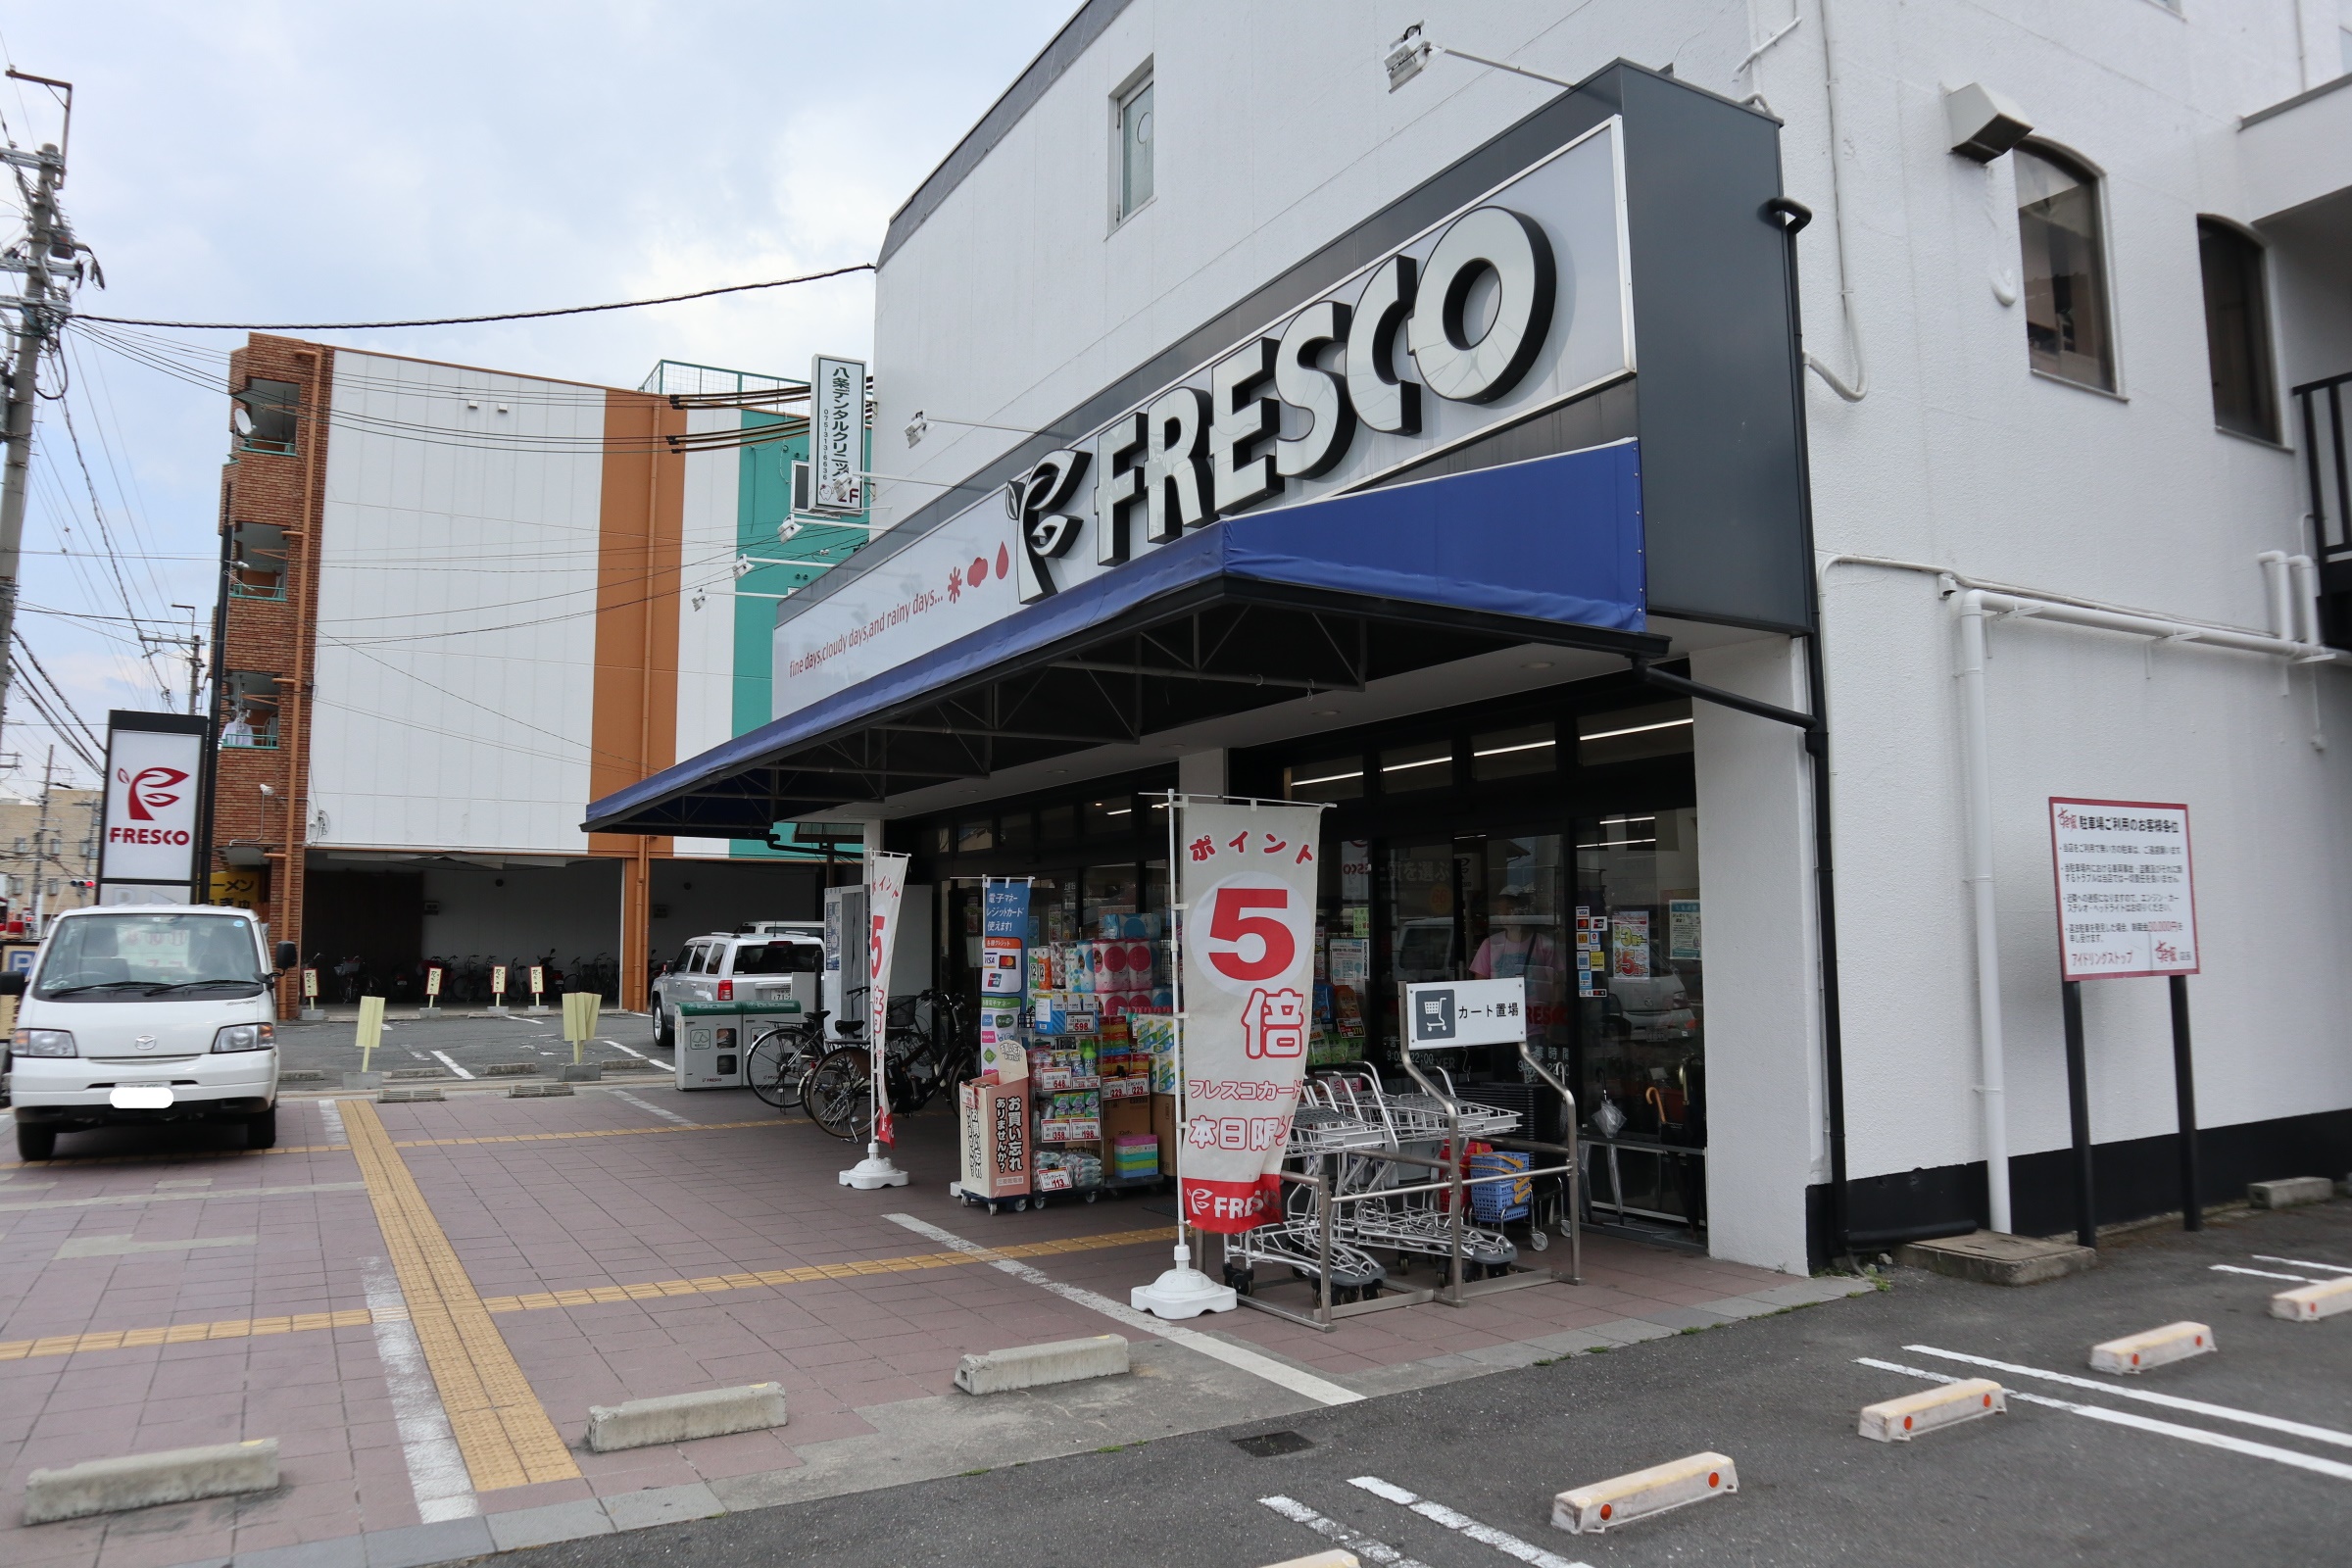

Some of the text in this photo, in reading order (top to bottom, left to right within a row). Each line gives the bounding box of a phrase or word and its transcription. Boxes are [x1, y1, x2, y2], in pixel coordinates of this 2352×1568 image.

[1095, 205, 1556, 567] FRESCO
[831, 367, 850, 481] 八条デンタルクリニッ
[789, 661, 804, 678] fine
[886, 601, 910, 628] rainy
[109, 827, 190, 847] FRESCO
[1189, 831, 1313, 865] ポイント
[988, 893, 1018, 904] 電子マネー
[1207, 887, 1295, 981] 5
[871, 914, 886, 980] 5
[1241, 987, 1305, 1059] 倍
[1457, 1003, 1519, 1019] カート置場
[1189, 1079, 1302, 1101] フレスコカード
[996, 1098, 1007, 1173] ありませんか?
[1007, 1097, 1023, 1171] お買い忘れ
